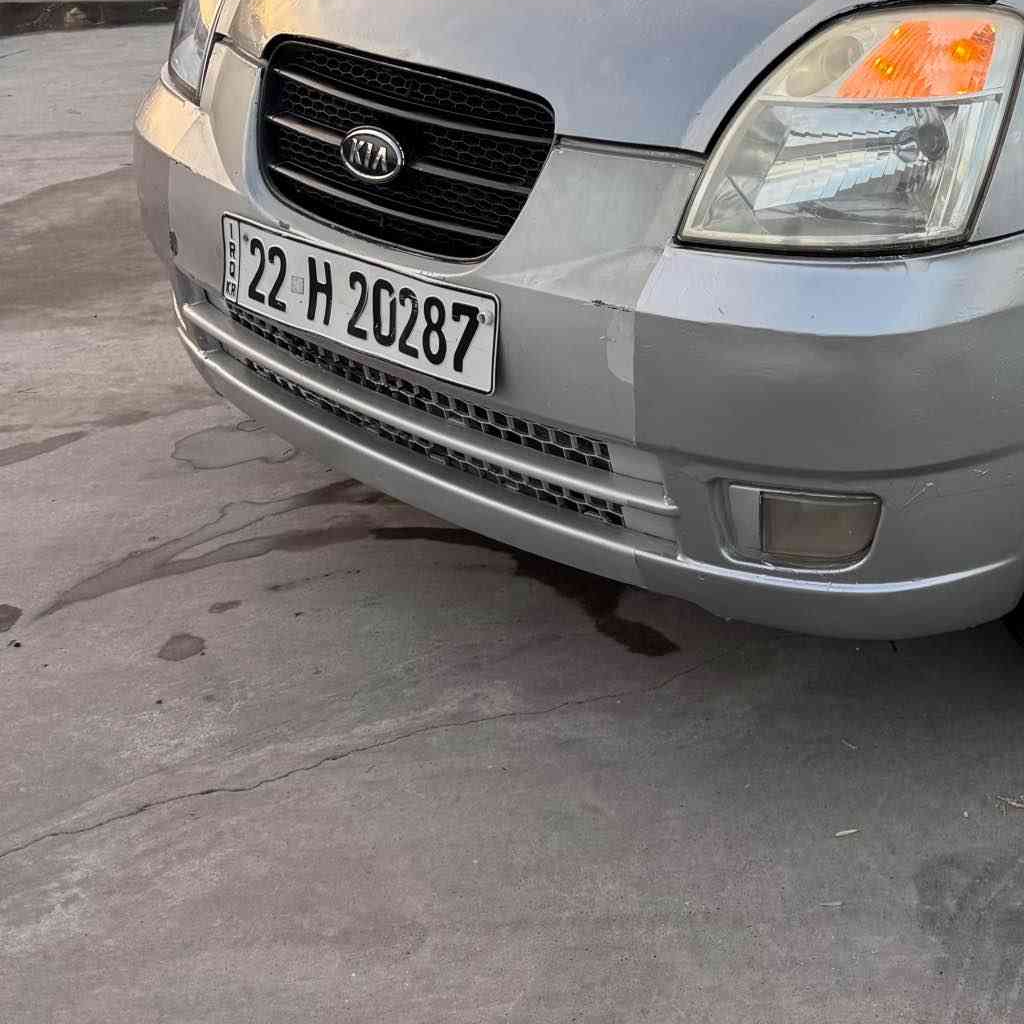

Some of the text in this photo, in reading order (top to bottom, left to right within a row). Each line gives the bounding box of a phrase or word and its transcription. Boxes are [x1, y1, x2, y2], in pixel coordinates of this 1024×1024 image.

[349, 137, 388, 172] KIA
[248, 237, 480, 373] 22 H 20287
